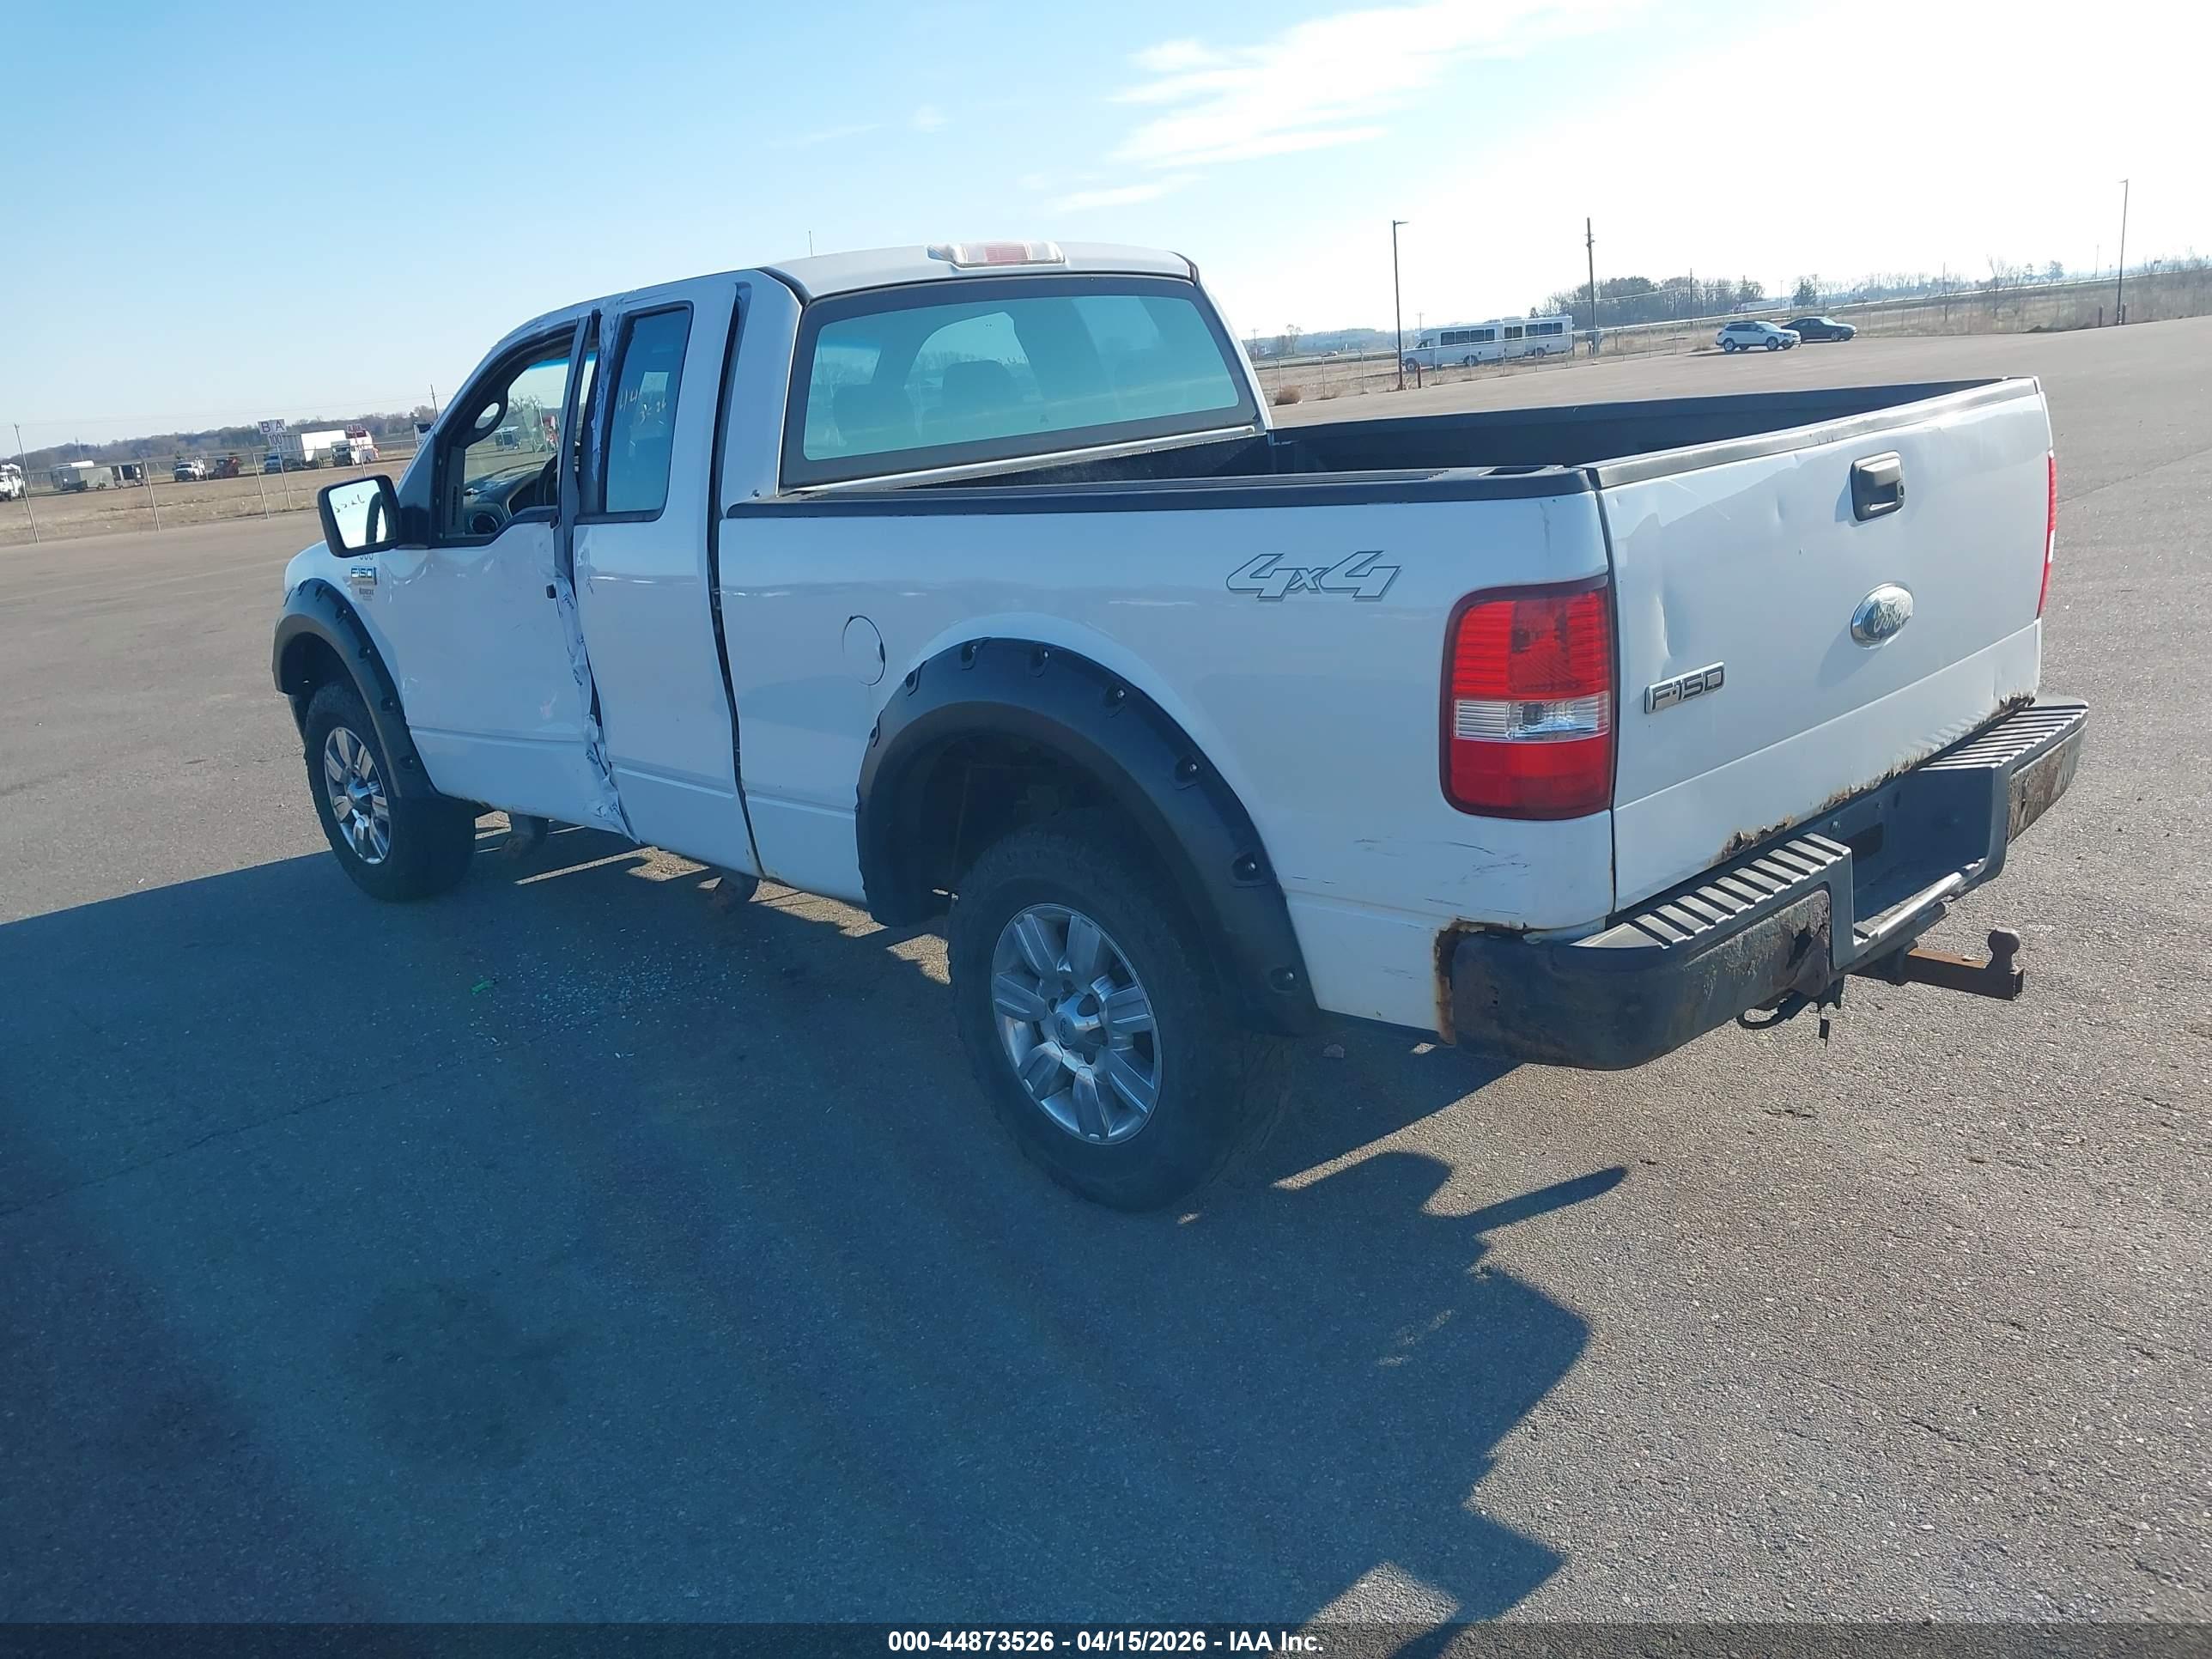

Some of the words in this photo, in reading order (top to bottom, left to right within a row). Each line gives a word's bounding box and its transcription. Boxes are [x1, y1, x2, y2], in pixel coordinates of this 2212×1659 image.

[260, 422, 271, 433] B
[275, 420, 285, 432] A
[269, 434, 283, 446] 100
[1226, 550, 1401, 599] 4x4
